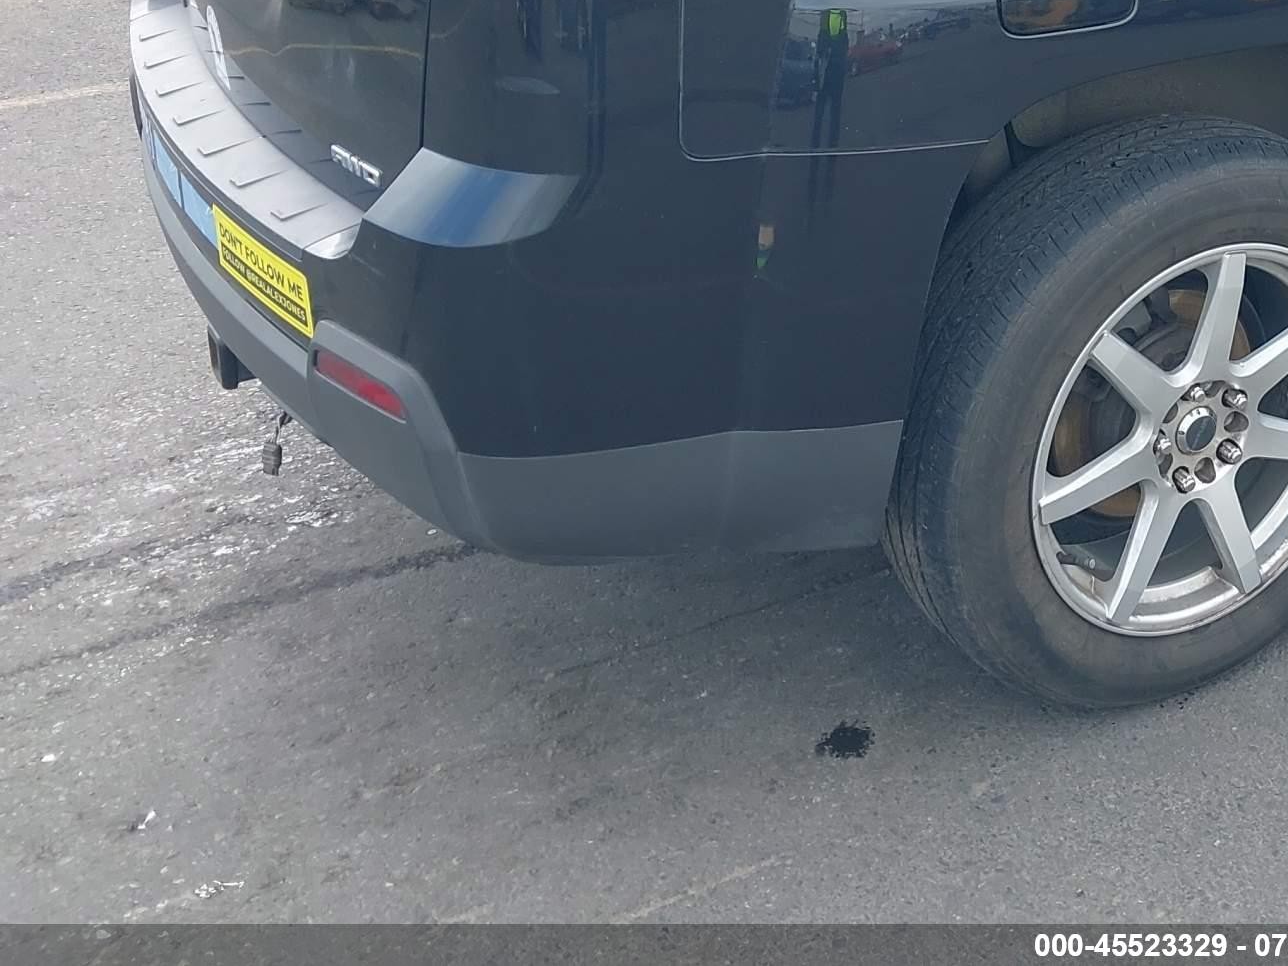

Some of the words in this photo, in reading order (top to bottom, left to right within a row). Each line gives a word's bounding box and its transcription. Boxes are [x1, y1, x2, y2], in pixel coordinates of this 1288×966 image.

[331, 144, 382, 187] AWD
[219, 221, 243, 256] DON'T
[244, 244, 285, 288] FOLLOW
[287, 277, 304, 302] ME
[222, 245, 246, 273] FOLLOW
